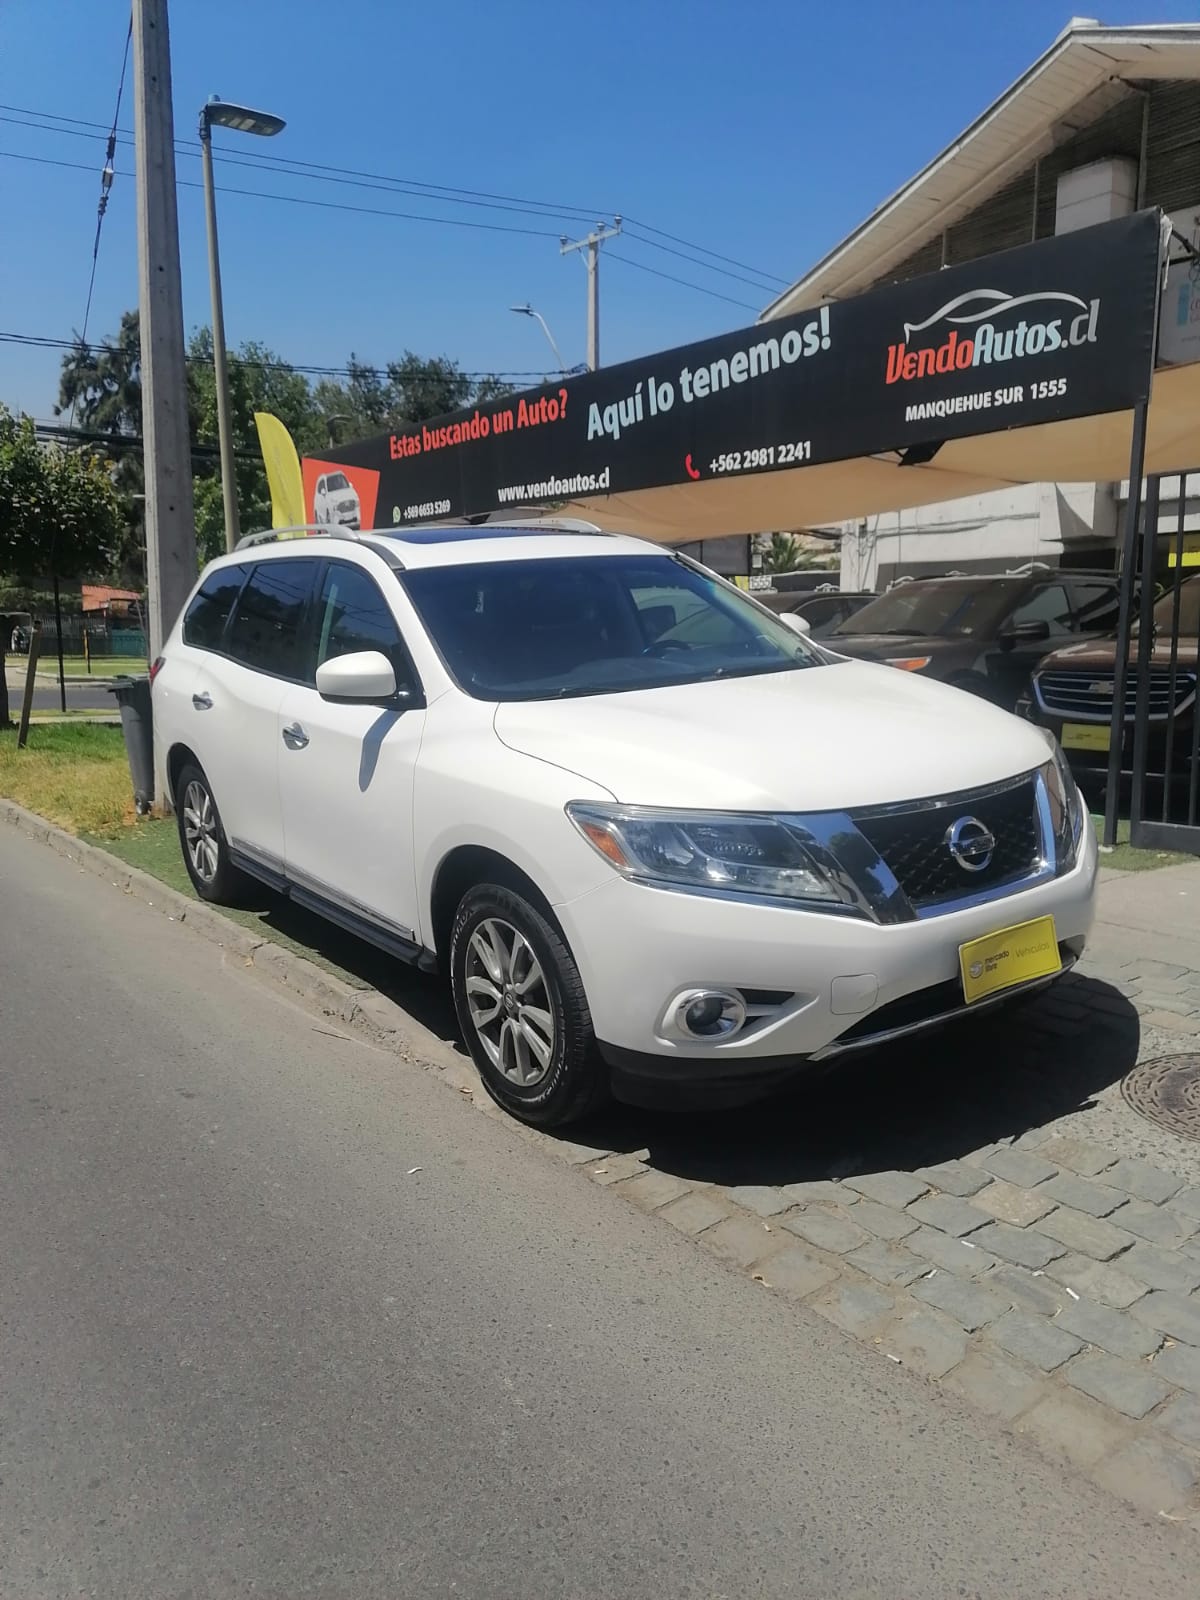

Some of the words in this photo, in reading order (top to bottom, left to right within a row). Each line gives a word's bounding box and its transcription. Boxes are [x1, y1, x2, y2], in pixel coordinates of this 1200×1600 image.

[886, 299, 1100, 384] VendoAutos.cl
[588, 382, 643, 441] Aquí
[648, 376, 674, 416] lo
[680, 306, 831, 403] tenemos!
[905, 391, 991, 422] MANQUEHUE
[993, 386, 1023, 407] SUR
[1030, 378, 1067, 400] 1555
[389, 434, 421, 460] Estas
[422, 410, 489, 452] buscando
[493, 409, 513, 434] un
[517, 388, 568, 428] Auto?
[498, 466, 609, 502] www.vendoautos.cl
[709, 452, 741, 473] +562
[743, 446, 774, 469] 2981
[778, 440, 810, 463] 2241
